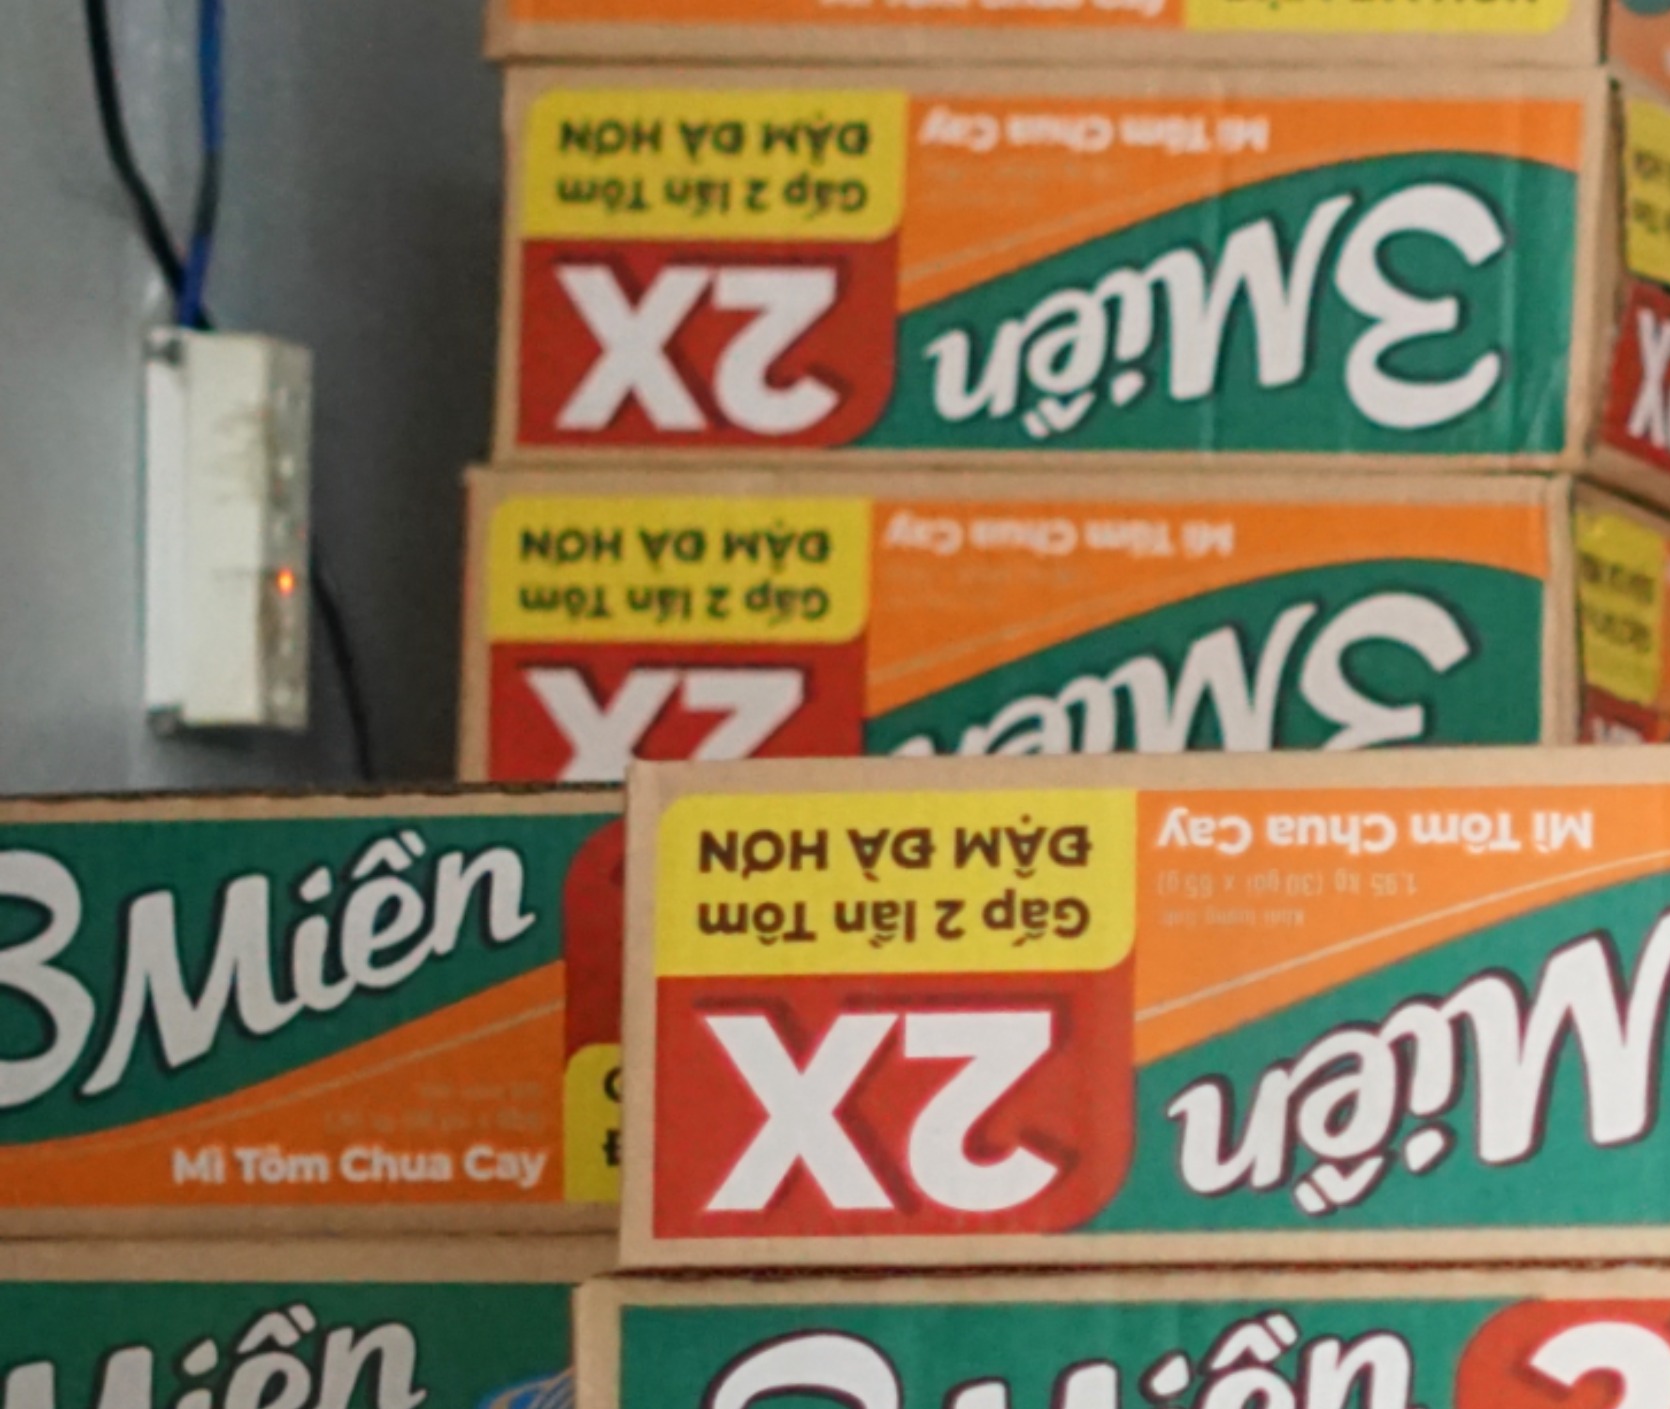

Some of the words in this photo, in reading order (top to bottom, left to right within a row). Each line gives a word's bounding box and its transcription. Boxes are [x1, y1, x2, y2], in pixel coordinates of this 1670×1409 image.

[560, 119, 664, 157] HƠN
[680, 121, 743, 161] ĐÀ
[762, 109, 870, 157] ĐẬM
[919, 107, 998, 152] Cay
[1006, 116, 1114, 152] Chua
[556, 178, 650, 214] Tôm
[748, 179, 768, 211] 2
[780, 176, 868, 220] Gấp
[553, 264, 840, 435] 2X
[519, 527, 622, 564] HƠN
[640, 529, 706, 567] ĐÀ
[723, 519, 831, 565] ĐẬM
[885, 512, 963, 552] Cay
[971, 519, 1079, 556] Chua
[519, 587, 611, 622] Tôm
[708, 587, 728, 619] 2
[743, 584, 829, 627] Gấp
[953, 816, 1093, 880] ĐẬM
[1157, 806, 1251, 852] Cay
[1264, 813, 1398, 857] Chua
[1410, 811, 1520, 856] Tôm
[1535, 811, 1594, 853] Mì
[698, 827, 829, 880] HƠN
[851, 825, 934, 886] ĐÀ
[698, 899, 817, 945] Tôm
[834, 897, 917, 947] lần
[937, 901, 963, 938] 2
[983, 896, 1090, 949] Gấp
[702, 1010, 1057, 1213] 2X
[171, 1145, 225, 1185] Mì
[233, 1144, 329, 1185] Tôm
[340, 1145, 452, 1183] Chua
[462, 1146, 548, 1190] Cay
